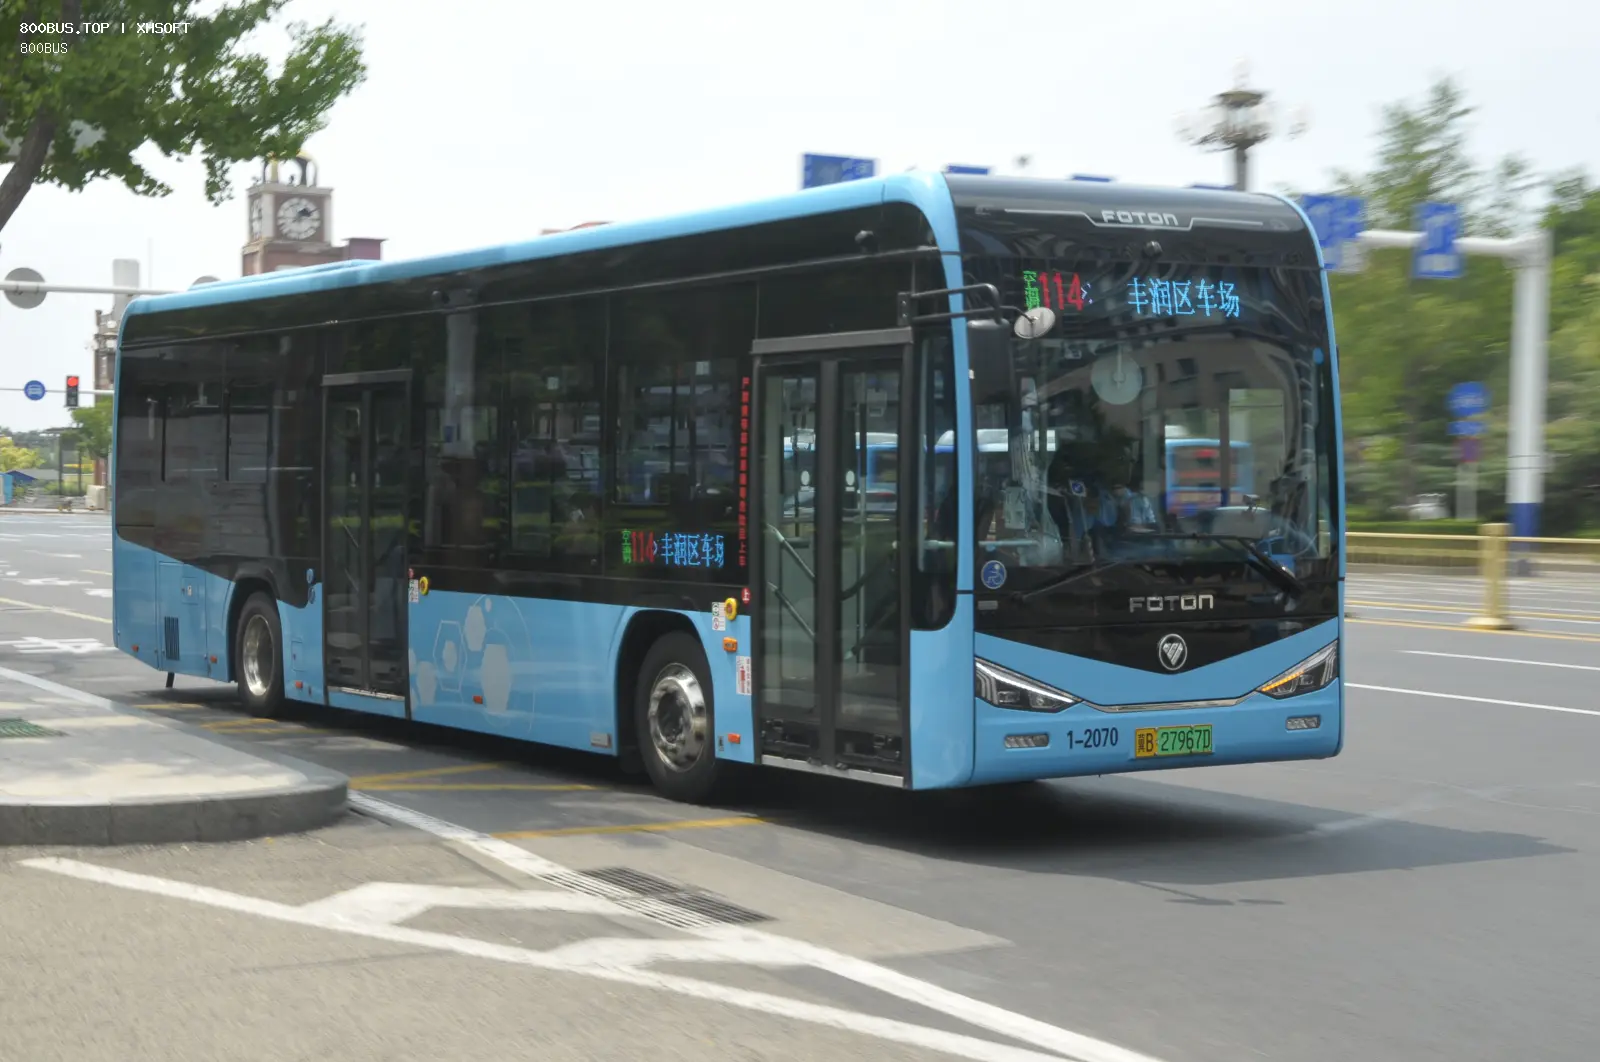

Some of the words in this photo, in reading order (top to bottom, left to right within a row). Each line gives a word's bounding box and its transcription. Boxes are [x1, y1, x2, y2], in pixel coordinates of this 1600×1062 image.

[1101, 210, 1179, 226] FOTON
[1038, 271, 1084, 311] 114
[1127, 277, 1241, 318] 丰润区车场
[631, 531, 655, 563] 114
[661, 532, 725, 568] 丰润区车场
[1129, 594, 1214, 613] FOTON
[1066, 726, 1119, 750] 1-2070
